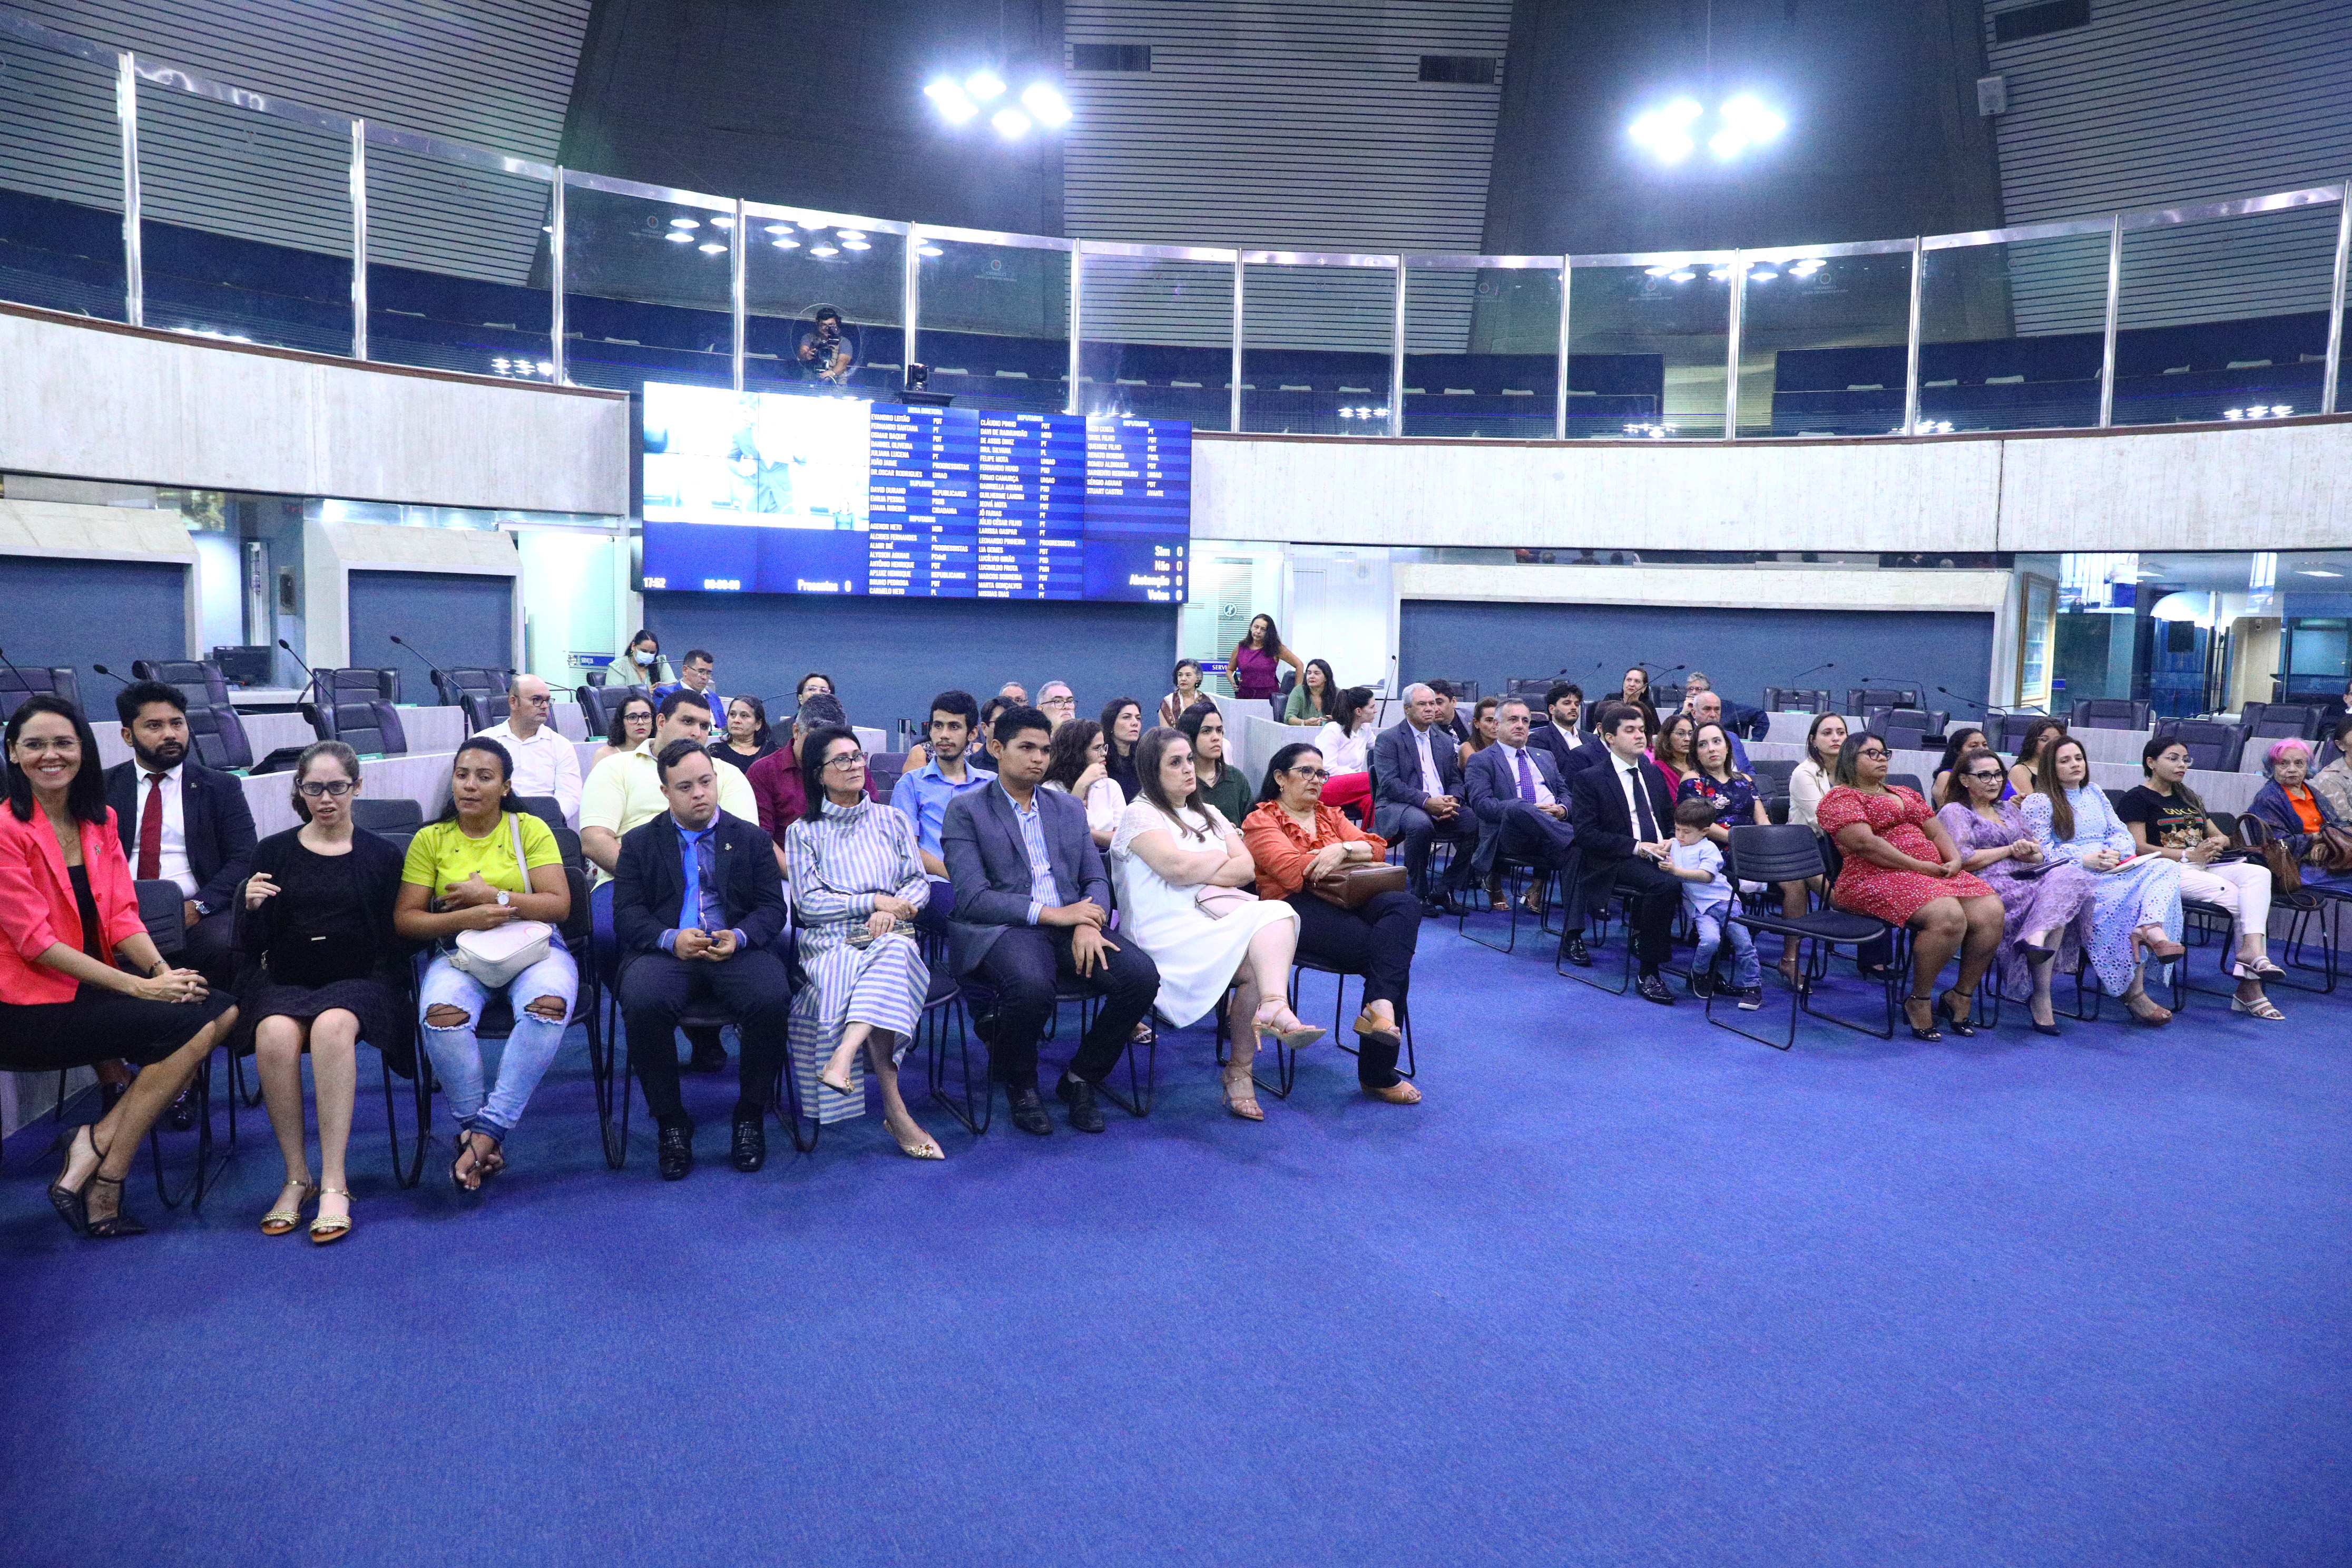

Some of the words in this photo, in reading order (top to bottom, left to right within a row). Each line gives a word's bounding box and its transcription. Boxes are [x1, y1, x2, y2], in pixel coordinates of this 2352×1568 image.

[1087, 477, 1104, 485] SÉRGIO
[1155, 546, 1170, 556] Sim
[1177, 546, 1182, 556] 0
[1155, 561, 1170, 571] Não
[1177, 561, 1182, 571] 0
[798, 579, 838, 591] Presentes
[845, 581, 851, 592] 0
[1130, 574, 1170, 587] Abstenção
[1176, 575, 1182, 586] 0
[1148, 590, 1170, 600] Votos
[1176, 590, 1182, 601] 0
